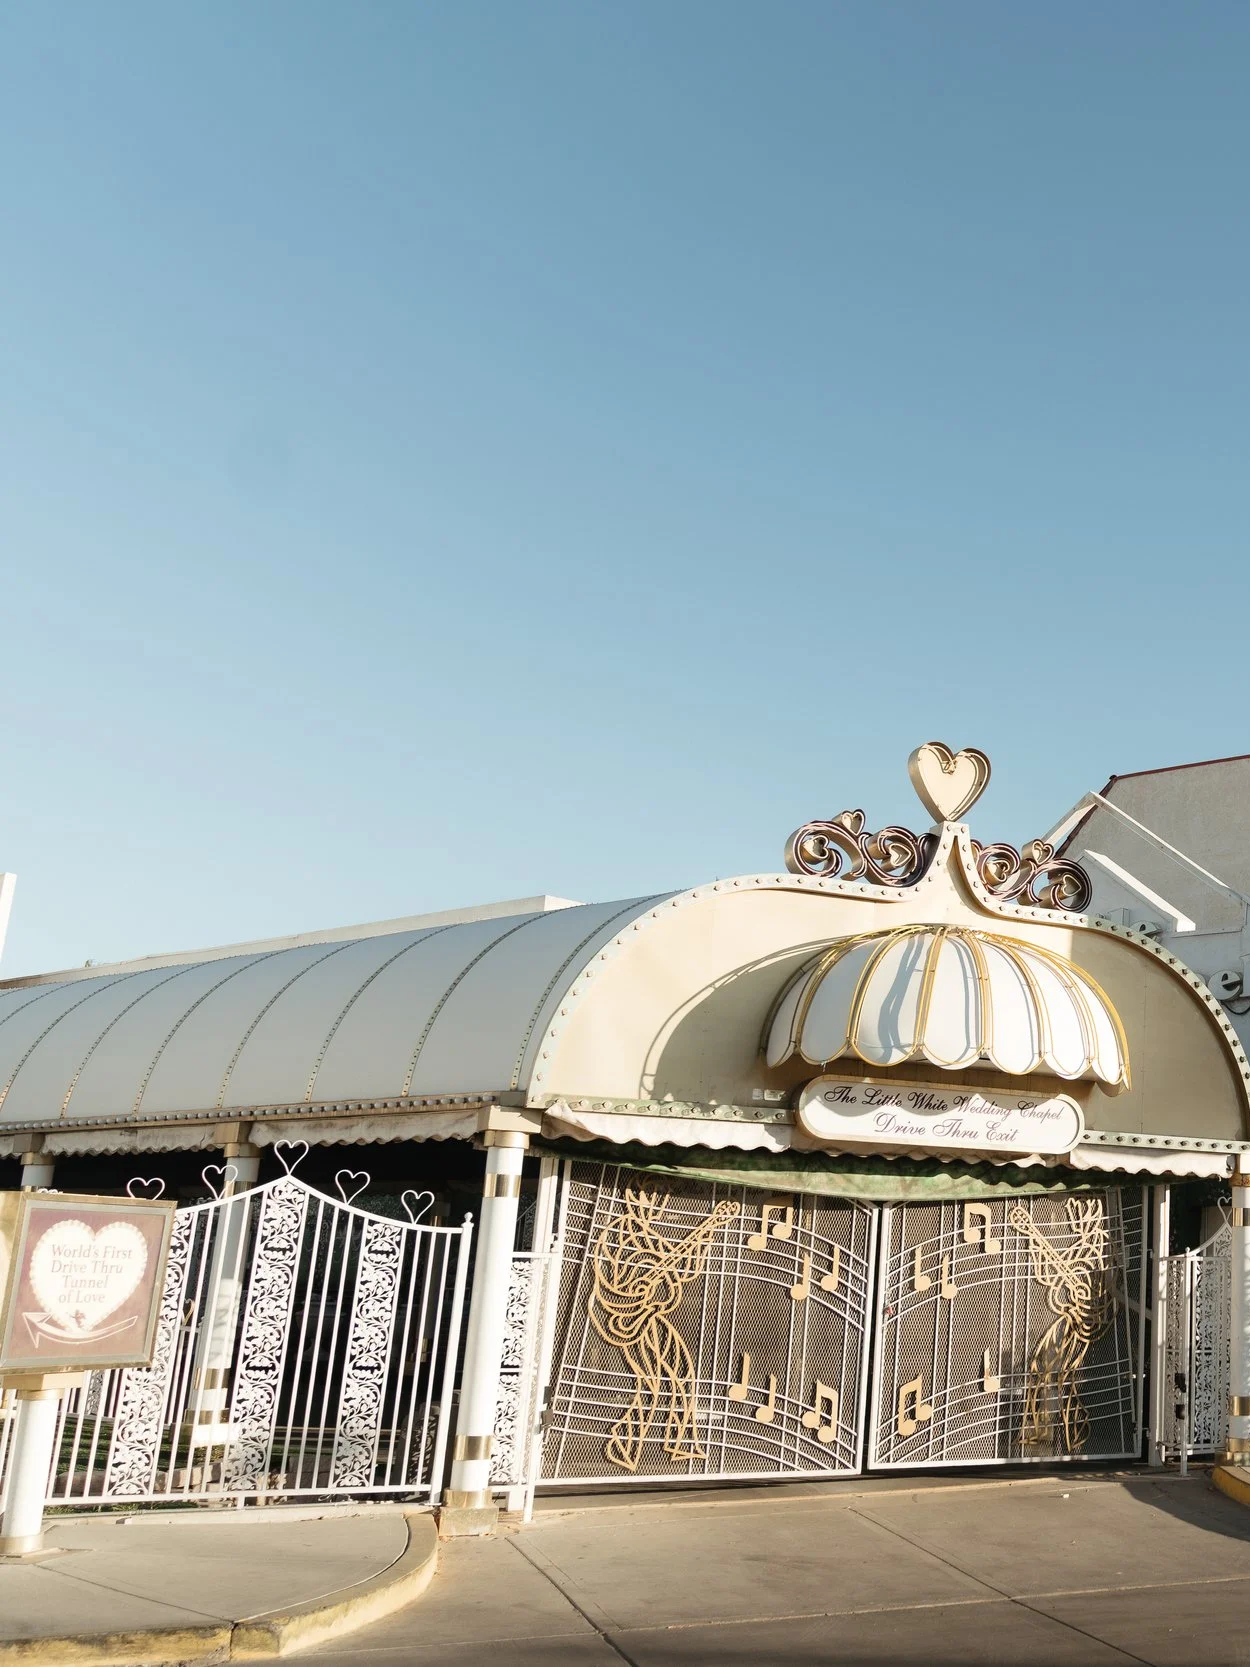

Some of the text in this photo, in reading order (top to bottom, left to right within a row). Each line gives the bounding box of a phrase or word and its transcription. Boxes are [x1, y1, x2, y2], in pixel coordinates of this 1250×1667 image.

[824, 1085, 1063, 1123] The Little White Wedding Chapel
[873, 1112, 1018, 1142] Drive Thru Exit
[51, 1243, 134, 1259] World's First
[51, 1260, 123, 1274] Drive Thru
[62, 1275, 109, 1289] Tunnel
[58, 1289, 105, 1304] of Love
